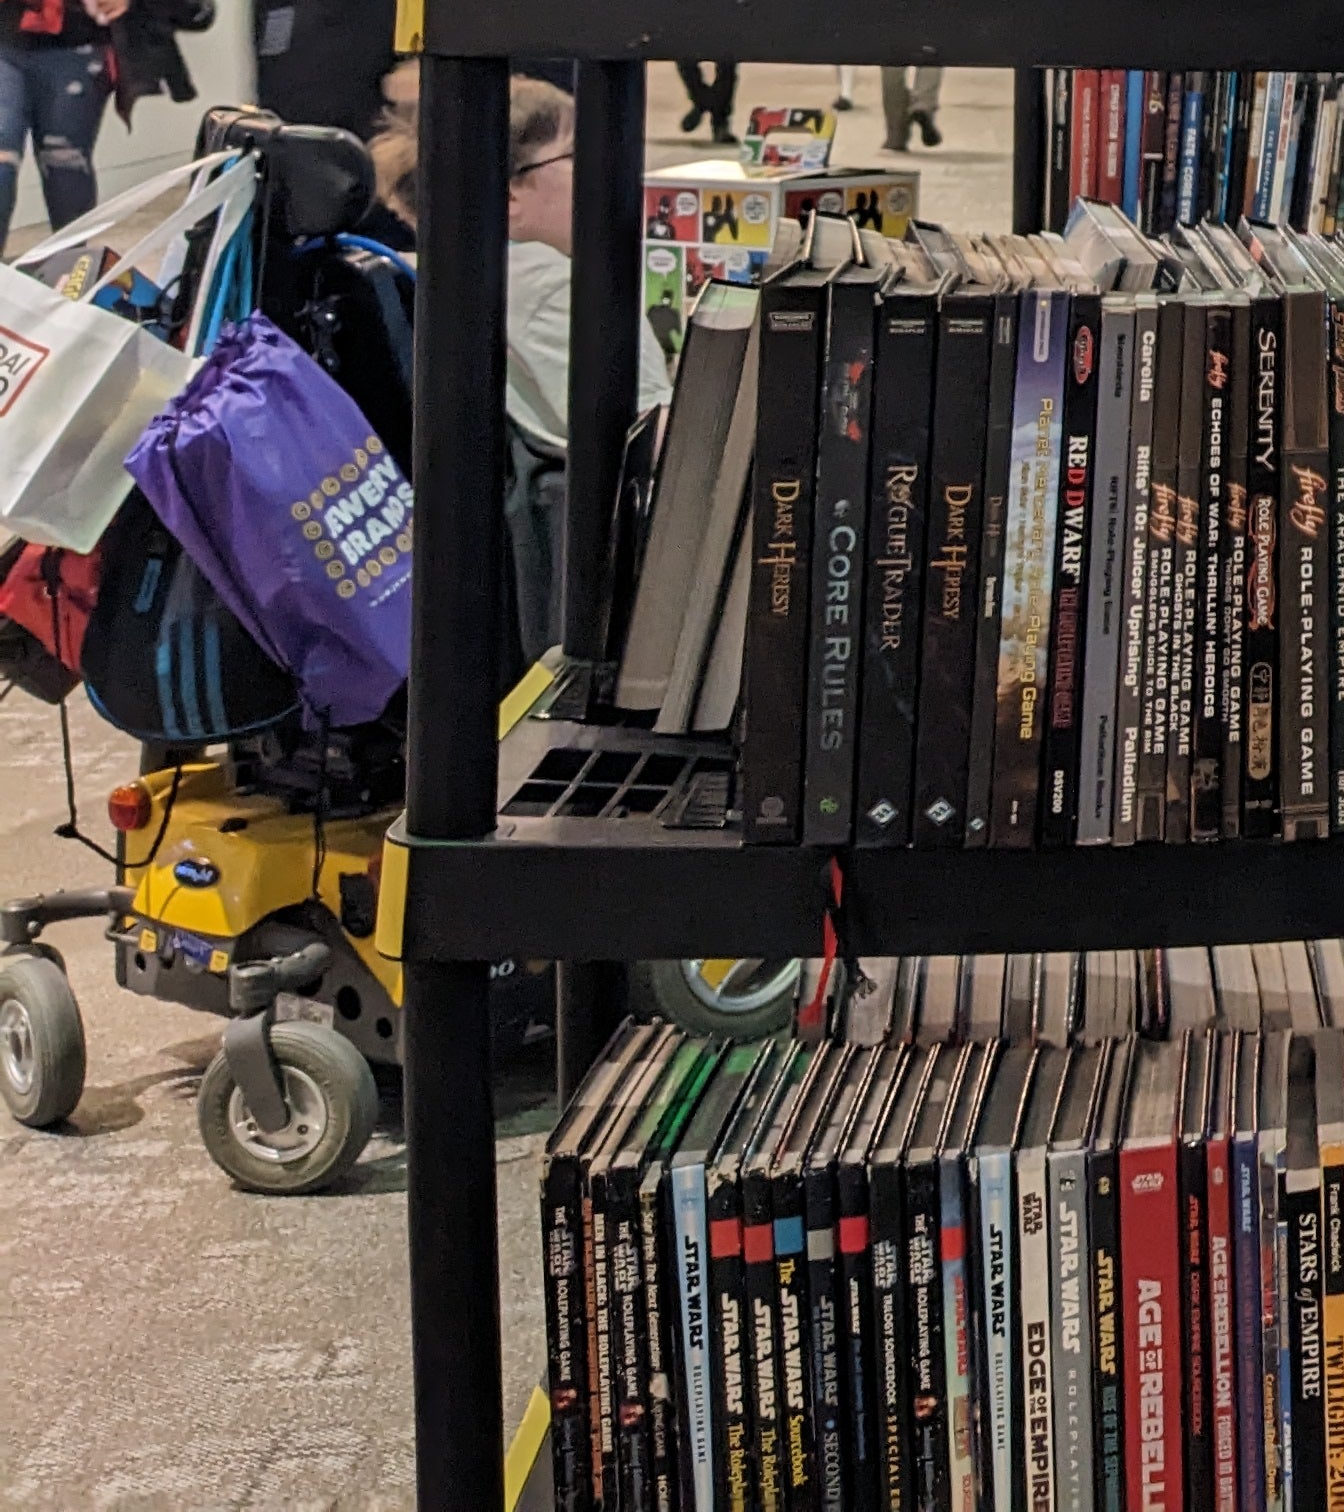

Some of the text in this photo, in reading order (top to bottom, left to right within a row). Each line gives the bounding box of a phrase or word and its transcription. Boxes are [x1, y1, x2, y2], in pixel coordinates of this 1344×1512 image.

[1139, 331, 1156, 402] Carella
[1255, 328, 1277, 471] SERENITY
[1061, 435, 1088, 581] RED DWARF
[820, 525, 856, 751] CORE RULES
[1289, 464, 1327, 795] firefly ROLE-PLAYING GAME
[1120, 727, 1139, 822] Palladium
[1060, 1201, 1081, 1354] STAR WARS
[1329, 1183, 1342, 1273] Frank Chadwick
[720, 1292, 743, 1442] STAR WARS The
[754, 1298, 775, 1449] STAR WARS The
[781, 1258, 808, 1487] The STAR WARS Sourcebook
[1137, 1279, 1162, 1371] AGE OF
[1295, 1212, 1320, 1399] STARS of EMPIRE
